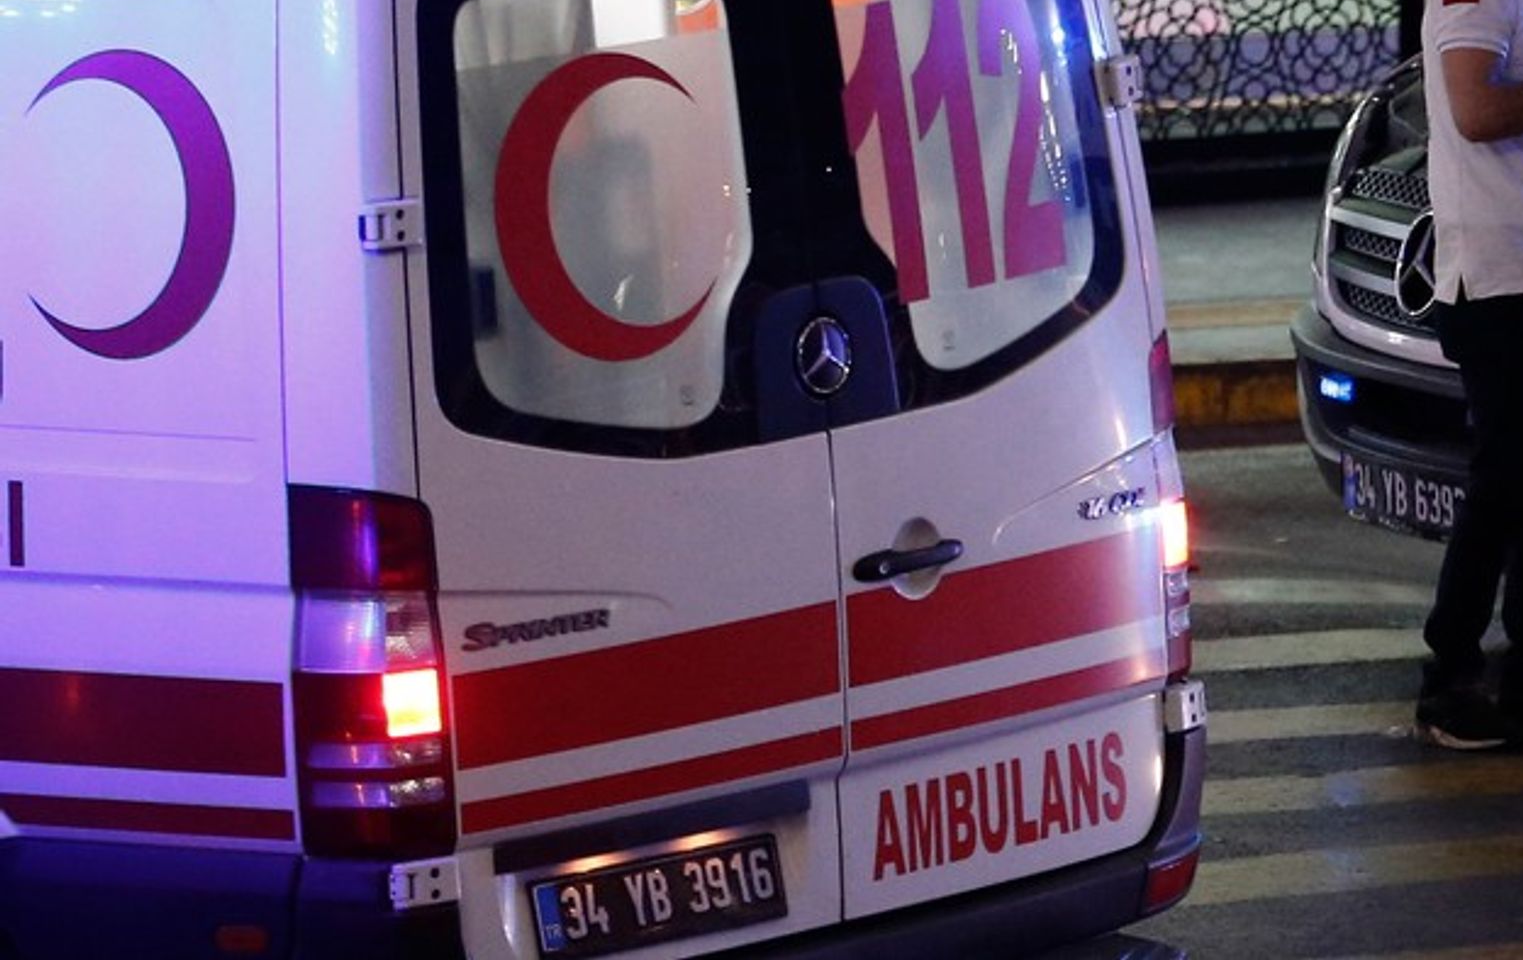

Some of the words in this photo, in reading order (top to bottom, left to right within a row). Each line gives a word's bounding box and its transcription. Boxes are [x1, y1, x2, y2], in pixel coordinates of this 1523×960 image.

[1354, 463, 1375, 509] 34
[1382, 469, 1407, 517] YB
[874, 731, 1128, 881] AMBULANS
[560, 884, 610, 940] 34
[624, 868, 673, 926] YB
[684, 848, 776, 912] 3916
